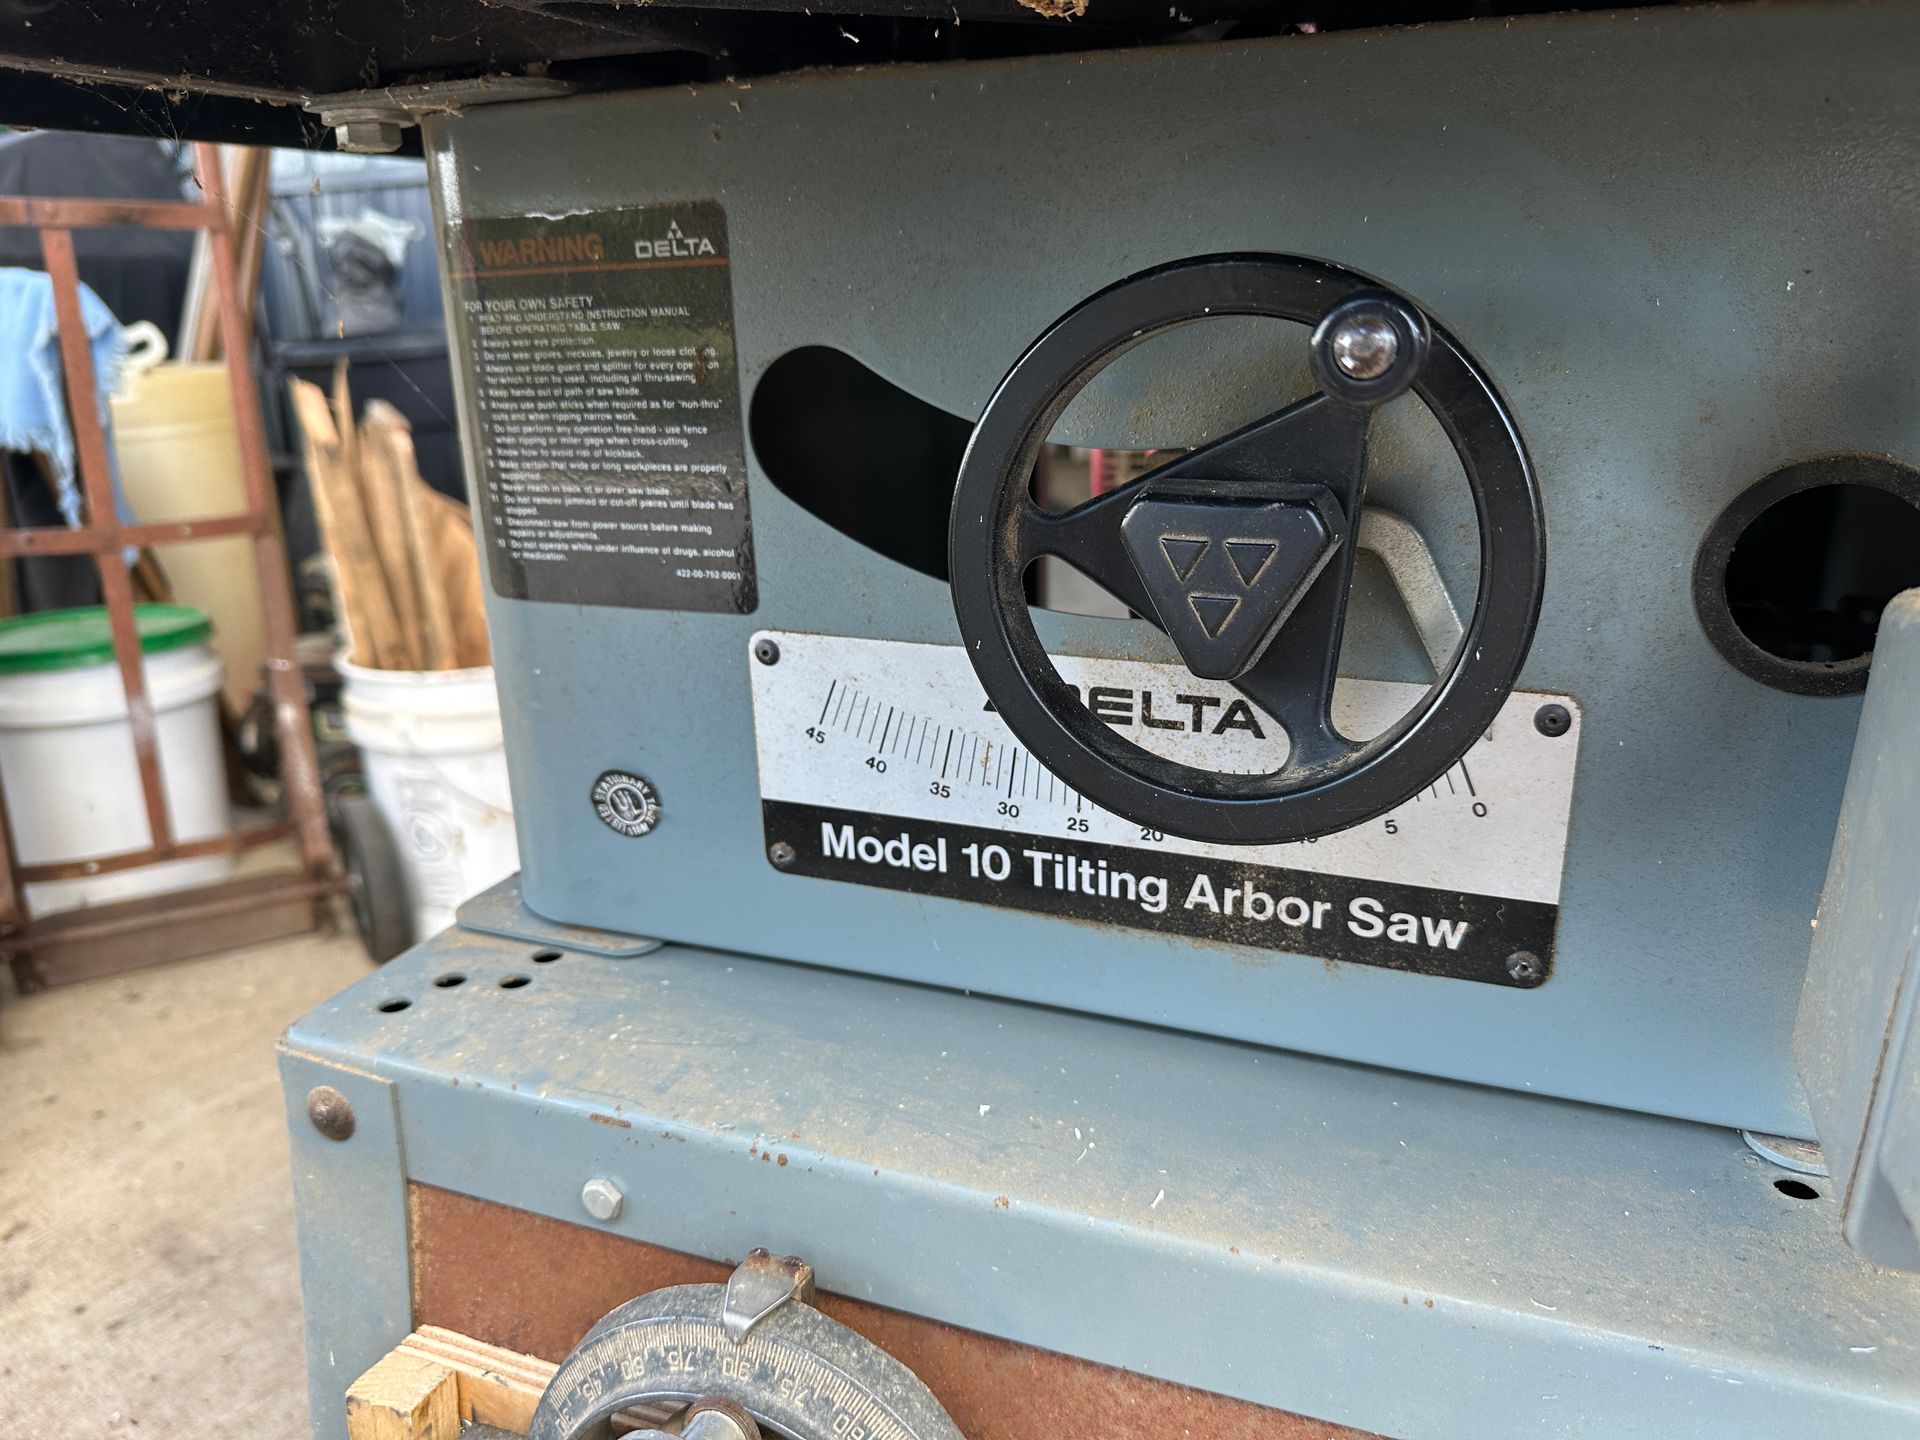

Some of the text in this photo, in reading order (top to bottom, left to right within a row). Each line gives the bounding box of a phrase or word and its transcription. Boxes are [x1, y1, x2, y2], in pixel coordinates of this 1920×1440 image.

[480, 233, 716, 266] WARNING DELTA
[464, 296, 593, 312] FOR YOUR OWN SAFETY
[504, 314, 523, 322] AND
[526, 311, 584, 322] UNDERSTAND
[587, 308, 648, 320] INSTRUCTION
[651, 306, 690, 317] MANUAL
[516, 323, 566, 334] OPERATING
[608, 348, 638, 359] jewelry
[641, 348, 650, 357] or
[653, 347, 677, 357] loose
[680, 346, 719, 358] clotng.
[486, 363, 513, 373] Always
[516, 363, 530, 372] use
[532, 362, 555, 372] blade
[558, 362, 582, 373] guard
[584, 362, 600, 371] and
[603, 361, 632, 372] splitter
[636, 361, 647, 370] for
[651, 362, 674, 371] every
[590, 374, 629, 385] including
[632, 374, 642, 383] all
[488, 389, 508, 398] Keep
[511, 388, 535, 397] hands
[537, 388, 551, 397] out
[553, 388, 562, 397] of
[565, 388, 583, 397] path
[585, 388, 594, 396] of
[616, 387, 643, 396] blade.
[490, 401, 518, 411] Always
[520, 402, 535, 410] use
[537, 401, 558, 411] push
[560, 400, 584, 410] sticks
[587, 400, 610, 409] when
[612, 400, 647, 411] required
[663, 400, 675, 409] for
[528, 411, 640, 422] when ripping narrow work.
[522, 424, 554, 434] perform
[557, 425, 572, 434] any
[574, 424, 613, 434] operation
[616, 424, 656, 433] free-hand
[665, 425, 680, 433] use
[683, 424, 708, 434] fence
[520, 437, 547, 447] ripping
[607, 437, 630, 445] when
[633, 436, 691, 448] cross-cutting.
[498, 447, 645, 458] Know how to avoid risk of kickback.
[551, 461, 567, 470] that
[569, 461, 589, 470] wide
[602, 462, 621, 472] long
[624, 462, 672, 473] workpieces
[674, 464, 688, 472] are
[691, 464, 728, 474] properly
[562, 484, 581, 493] back
[606, 486, 624, 494] over
[646, 486, 672, 495] blade.
[533, 496, 562, 505] remove
[564, 497, 597, 507] jammed
[599, 498, 607, 506] or
[610, 498, 638, 507] cut-off
[640, 499, 668, 509] pieces
[670, 499, 689, 509] until
[691, 500, 715, 509] blade
[718, 500, 734, 510] has
[507, 518, 713, 536] Disconnect saw from power source before making
[540, 542, 569, 552] operate
[571, 543, 593, 552] while
[595, 544, 619, 553] under
[622, 544, 660, 555] influence
[662, 546, 671, 556] of
[673, 547, 701, 558] drugs,
[703, 547, 736, 558] alcohol
[805, 725, 826, 745] 45
[865, 756, 887, 774] 40
[929, 781, 951, 799] 35
[997, 801, 1020, 818] 30
[1472, 801, 1488, 818] 0
[1066, 816, 1090, 833] 25
[1384, 818, 1399, 835] 5
[1140, 826, 1164, 842] 20
[821, 821, 1469, 951] Model 10 Tilting Arbor Saw
